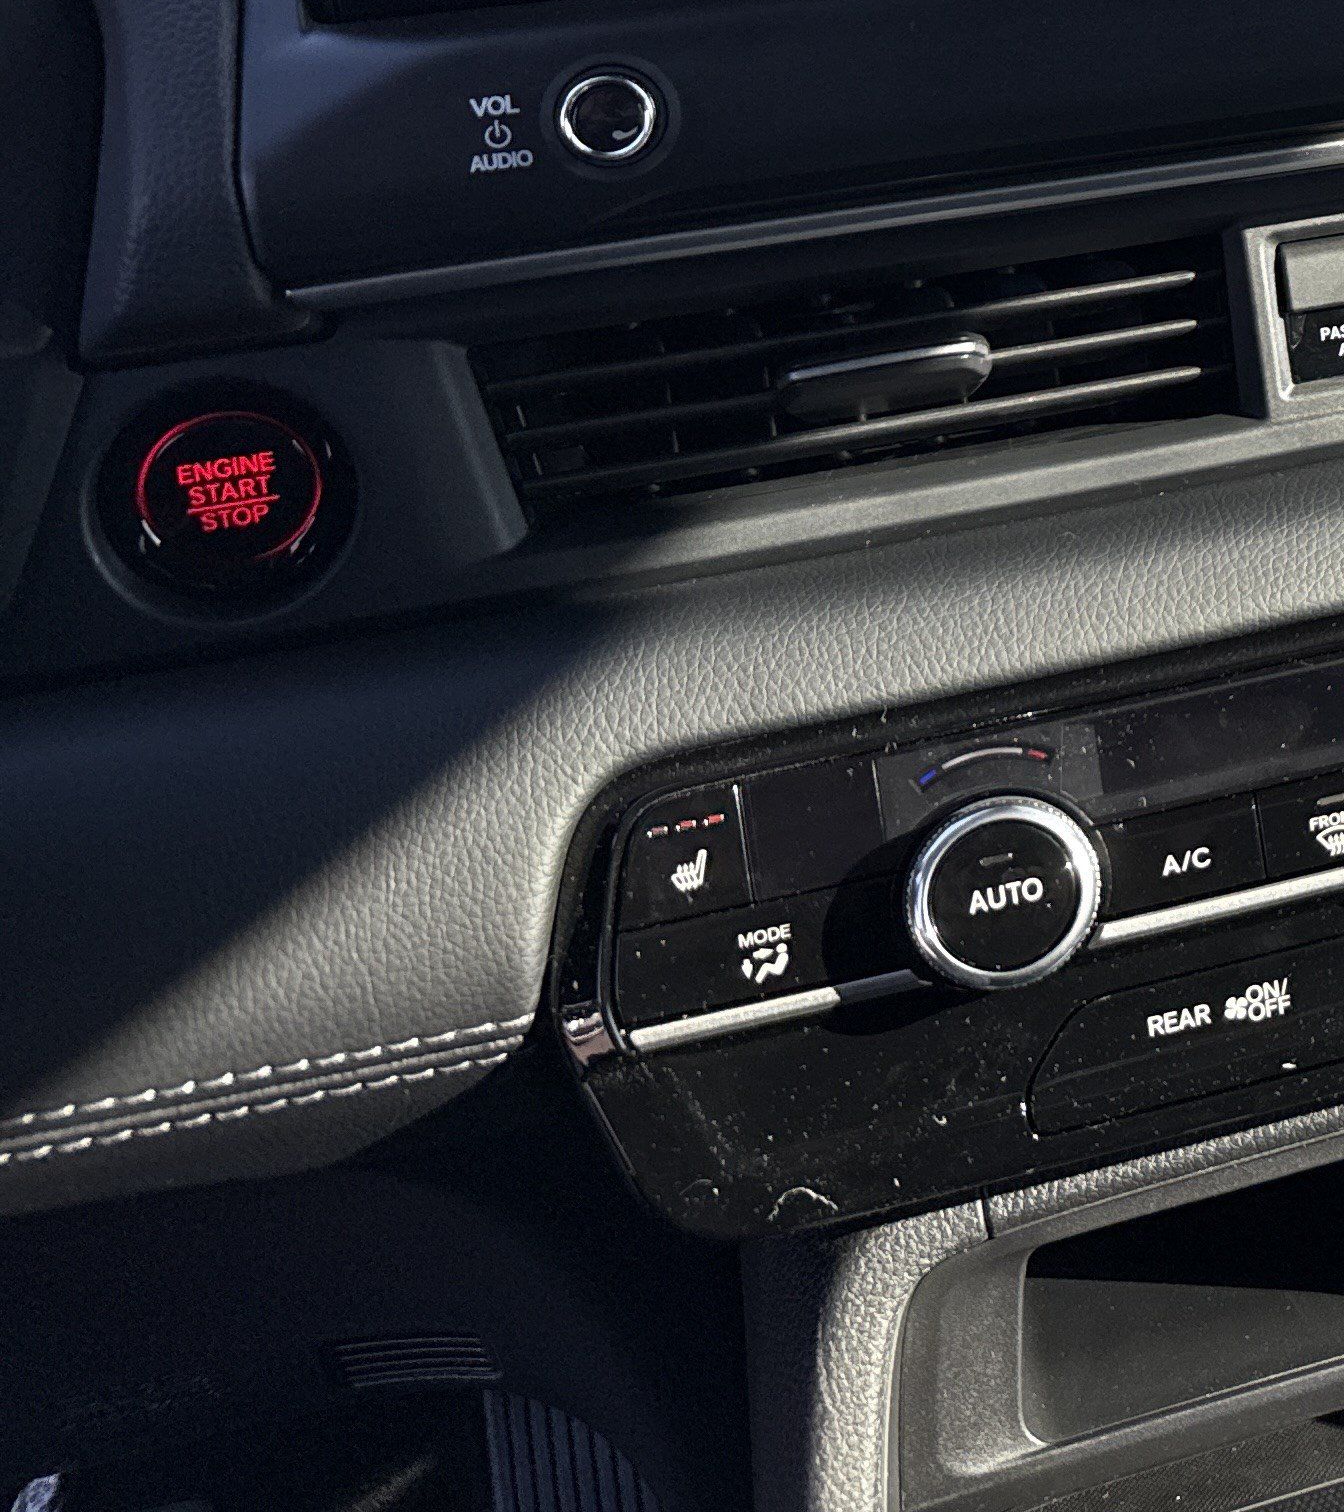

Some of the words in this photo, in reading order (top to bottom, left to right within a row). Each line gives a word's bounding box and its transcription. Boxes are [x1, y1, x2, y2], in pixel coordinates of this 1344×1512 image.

[470, 95, 520, 117] VOL
[470, 150, 533, 172] AUDIO
[177, 451, 276, 486] ENGINE
[189, 475, 273, 507] START
[200, 503, 270, 533] STOP
[1163, 847, 1211, 876] A/C
[970, 878, 1043, 915] AUTO
[738, 923, 792, 949] MODE
[1246, 977, 1288, 1004] ON/
[1147, 1004, 1211, 1037] REAR
[1247, 995, 1292, 1023] OFF
